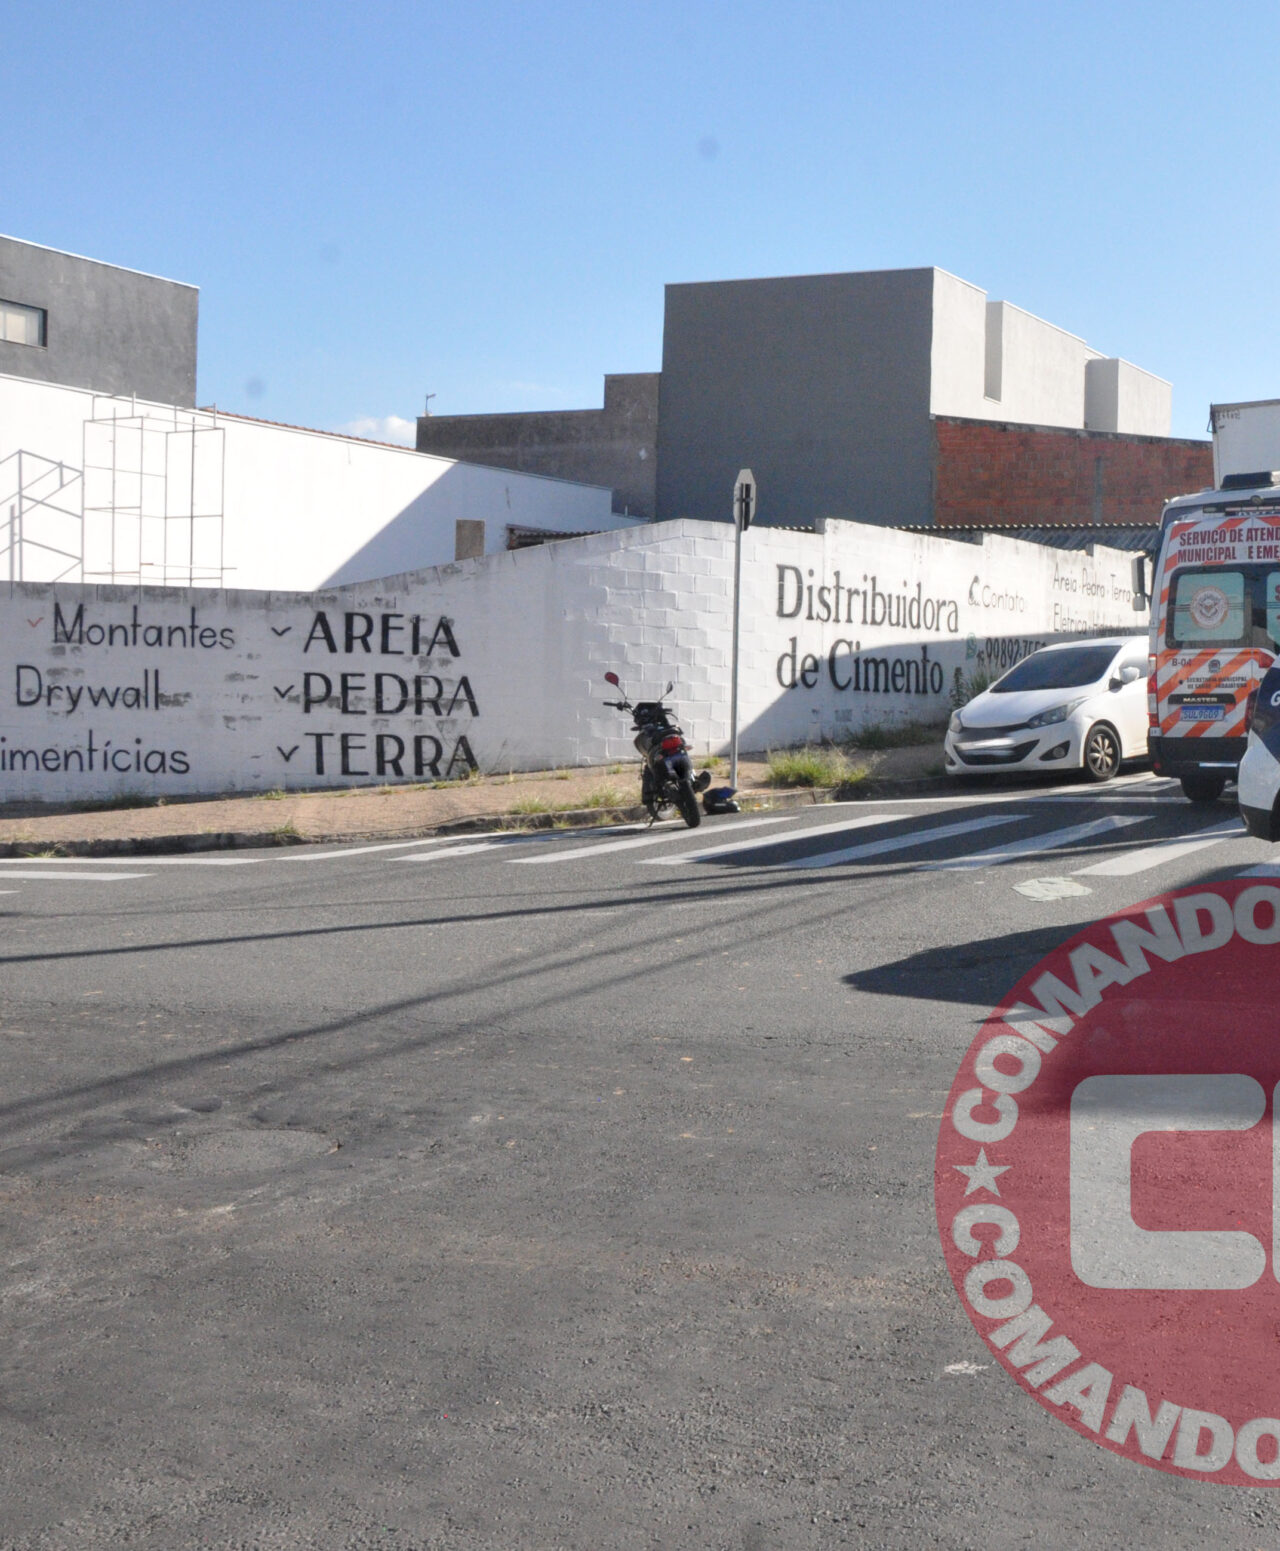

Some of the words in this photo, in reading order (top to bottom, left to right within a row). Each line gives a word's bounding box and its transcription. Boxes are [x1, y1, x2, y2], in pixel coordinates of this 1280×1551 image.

[1176, 548, 1238, 564] MUNICIPAL
[1248, 547, 1255, 560] E
[1180, 531, 1227, 547] SERVIÇO
[1229, 529, 1244, 543] DE
[776, 563, 959, 633] Distribuidora
[981, 585, 1025, 612] Contato
[1052, 562, 1078, 593] Areia
[1081, 567, 1106, 599] Pedra
[1110, 573, 1132, 603] Terra
[52, 602, 235, 648] Montantes
[303, 611, 461, 657] AREIA
[15, 664, 160, 713] Drywall
[776, 637, 819, 690] de
[827, 637, 944, 695] Cimento
[303, 672, 480, 717] PEDRA
[0, 729, 191, 775] imentícias
[304, 732, 480, 777] TERRA
